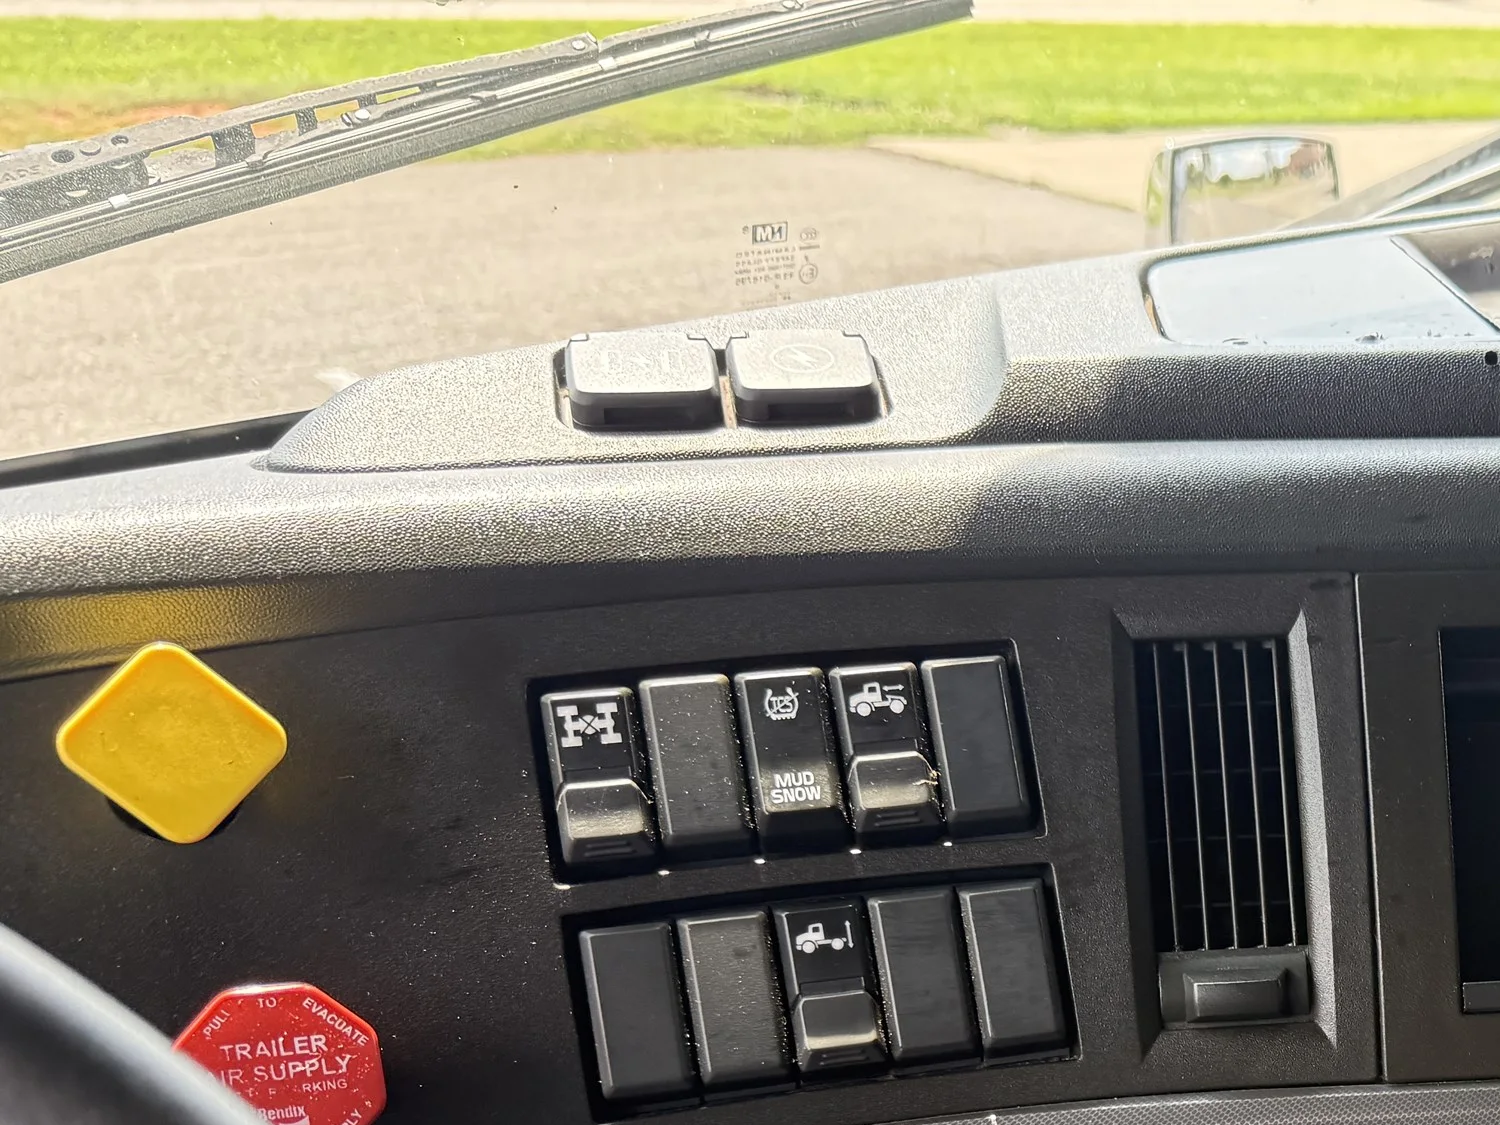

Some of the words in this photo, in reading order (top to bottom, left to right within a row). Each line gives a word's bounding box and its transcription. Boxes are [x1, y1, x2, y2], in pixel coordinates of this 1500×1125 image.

[774, 771, 815, 788] MUD
[770, 786, 820, 804] SNOW
[257, 997, 277, 1008] TO
[302, 997, 370, 1046] EVACUATE
[219, 1034, 328, 1061] TRAILER
[253, 1054, 351, 1083] SUPPLY
